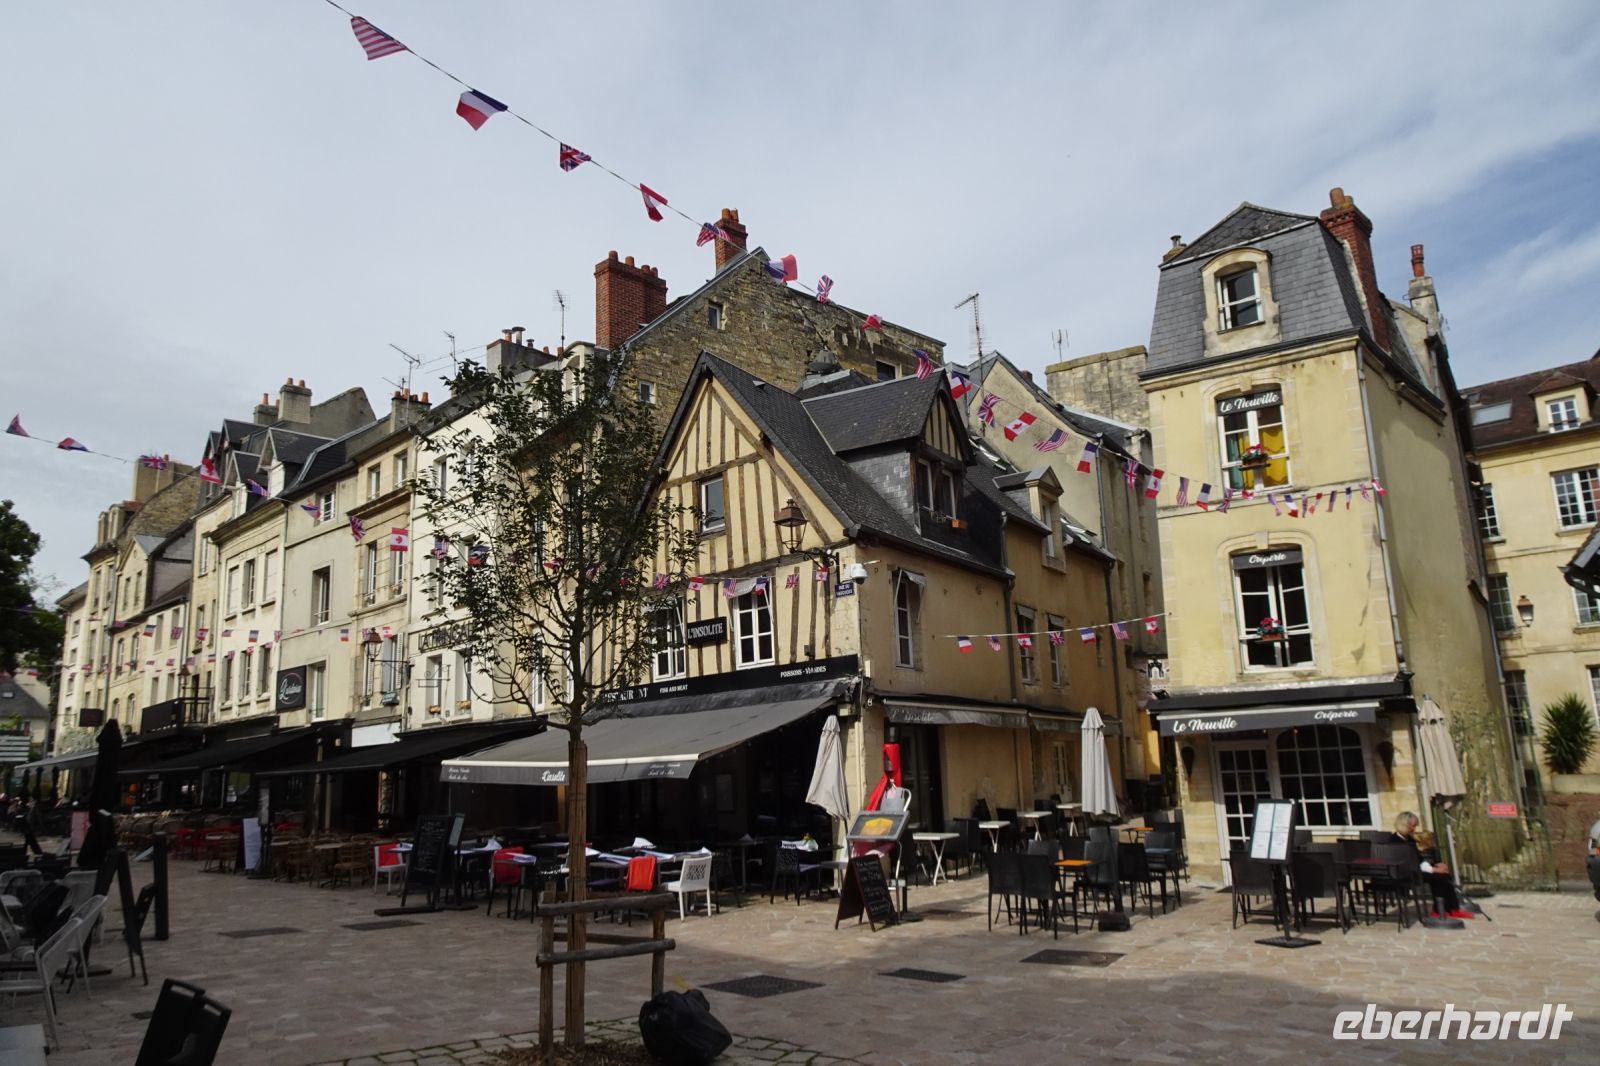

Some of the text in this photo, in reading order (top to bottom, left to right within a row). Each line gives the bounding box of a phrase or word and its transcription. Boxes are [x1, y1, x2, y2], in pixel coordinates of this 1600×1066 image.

[1220, 392, 1280, 413] Le Neuville
[687, 622, 723, 639] L'INSOLITE
[1314, 709, 1359, 721] Crêperie
[1172, 717, 1238, 733] Le Neuville
